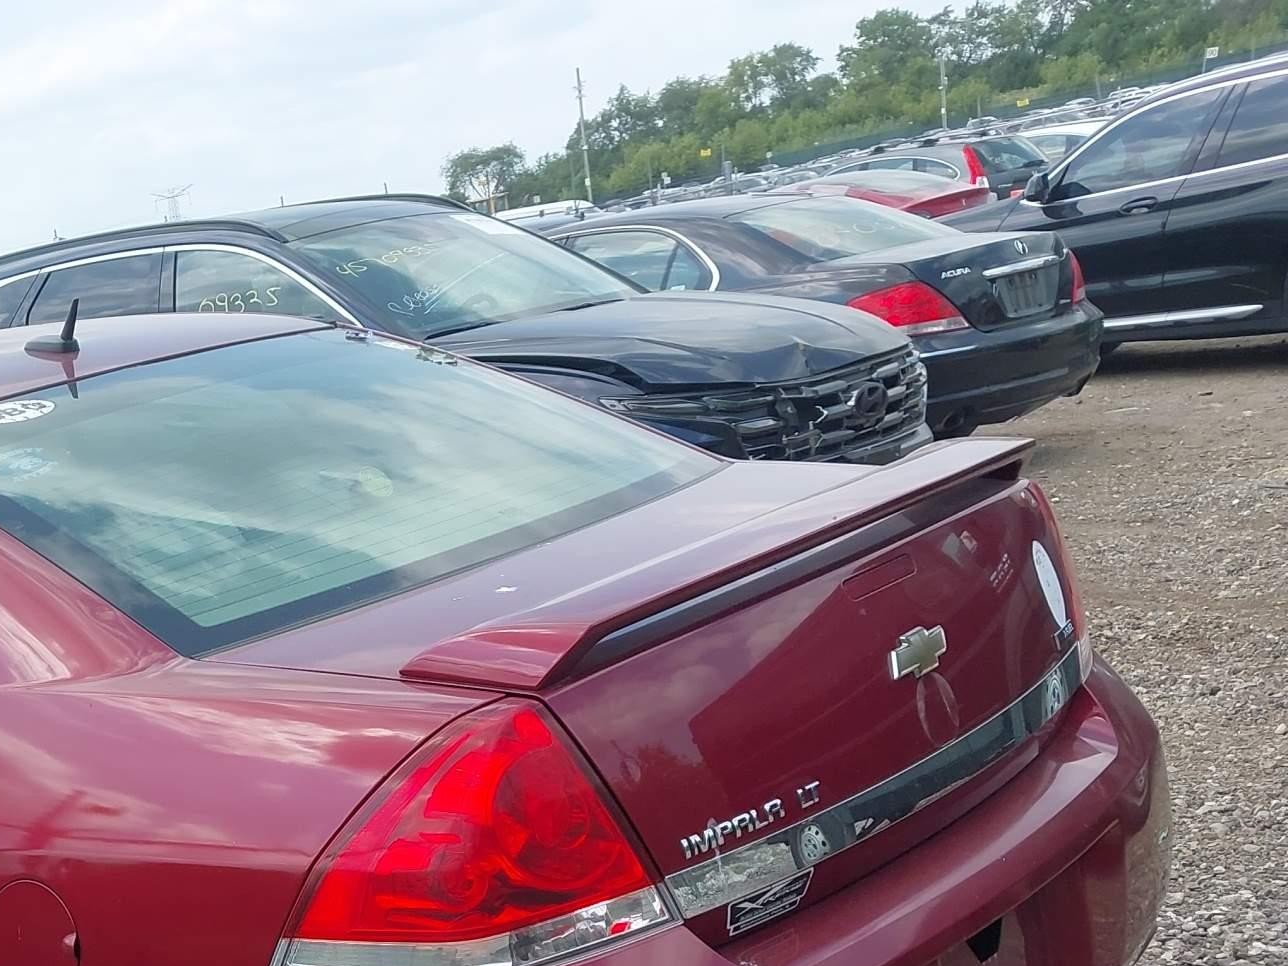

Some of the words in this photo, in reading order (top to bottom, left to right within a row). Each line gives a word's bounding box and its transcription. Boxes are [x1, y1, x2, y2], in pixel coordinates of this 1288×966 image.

[941, 267, 972, 279] ACURA
[680, 798, 786, 860] IMPALA
[796, 780, 820, 809] LT
